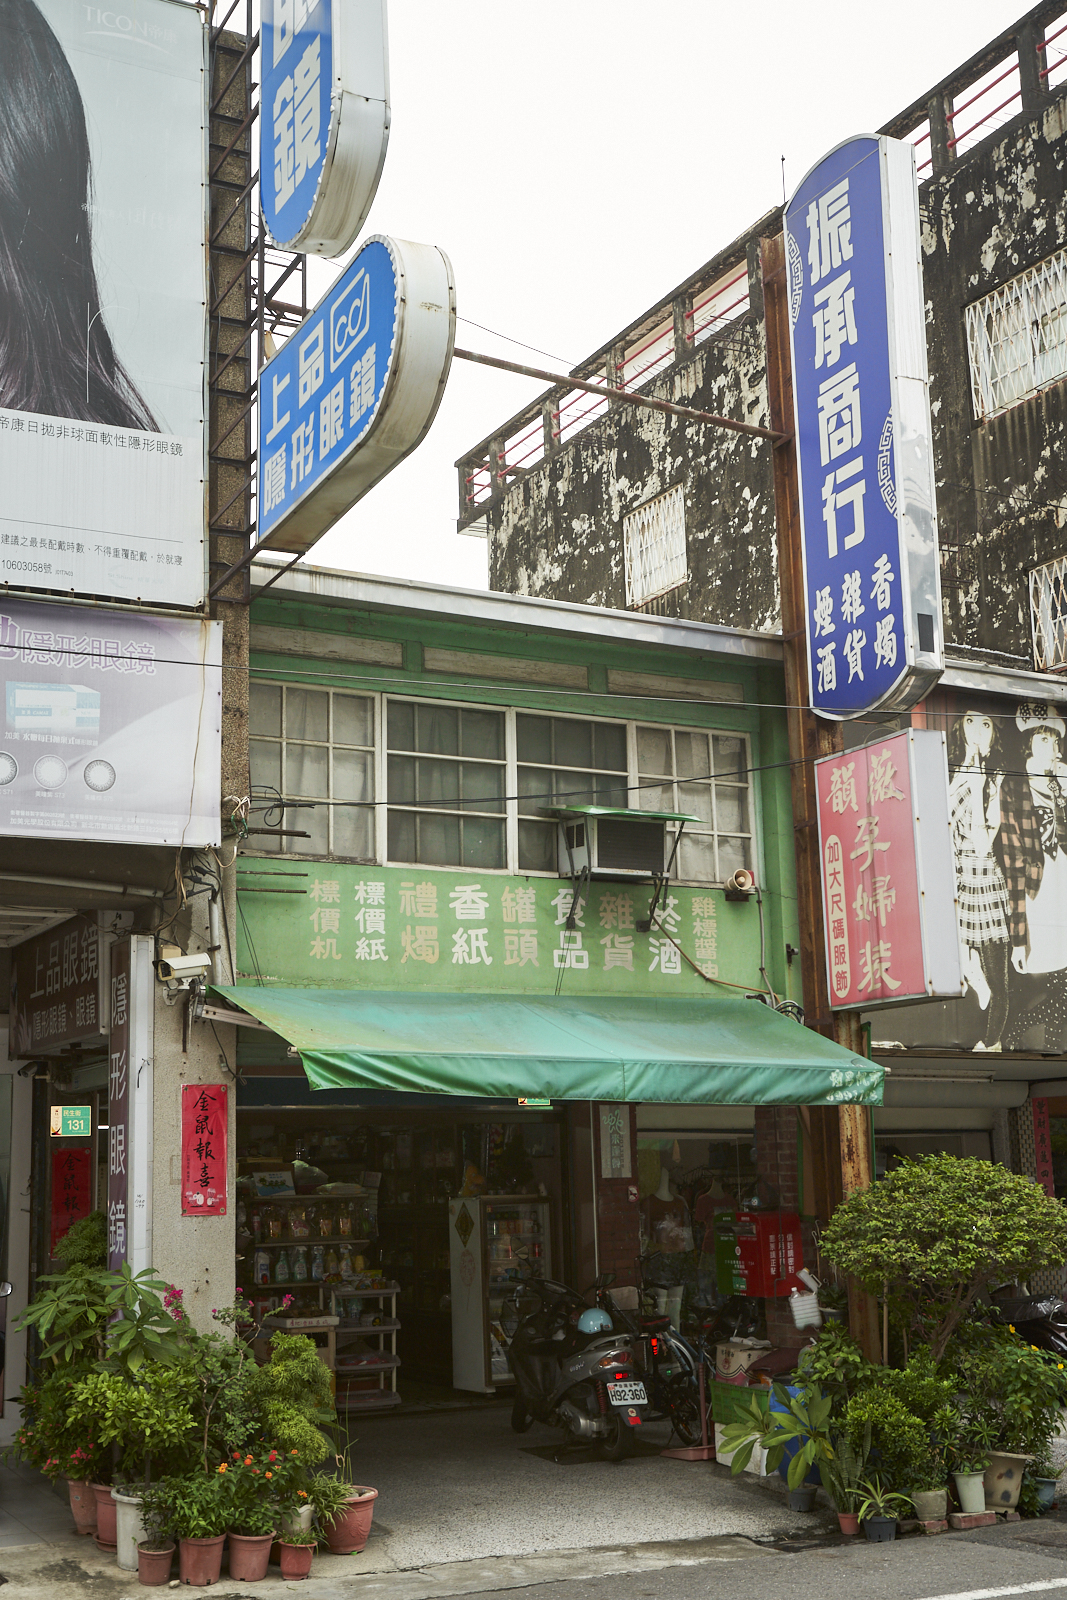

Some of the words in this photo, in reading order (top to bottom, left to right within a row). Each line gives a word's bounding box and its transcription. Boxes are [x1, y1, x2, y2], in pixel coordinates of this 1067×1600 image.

[82, 4, 148, 37] TICON
[265, 319, 325, 446] 上品
[805, 177, 867, 559] 振承商行
[263, 342, 377, 516] 隱形眼鏡
[1, 559, 53, 575] 10603058號
[813, 585, 837, 694] 煙酒
[840, 569, 867, 684] 雜貨
[870, 553, 897, 668] 香燭
[354, 880, 389, 961] 標價紙
[398, 881, 440, 965] 禮燭
[448, 884, 493, 966] 香紙
[500, 885, 540, 967] 罐頭
[551, 888, 589, 969] 食品
[600, 891, 635, 972] 雜貨
[827, 842, 848, 992] 加大尺碼服飾
[850, 815, 902, 993] 孕婦裝
[29, 924, 99, 999] 上品眼鏡
[63, 1109, 82, 1117] 民生街
[67, 1119, 84, 1130] 131
[109, 970, 128, 1254] 隱形眼鏡
[192, 1090, 217, 1188] 金鼠報喜
[610, 1388, 646, 1402] H92-360
